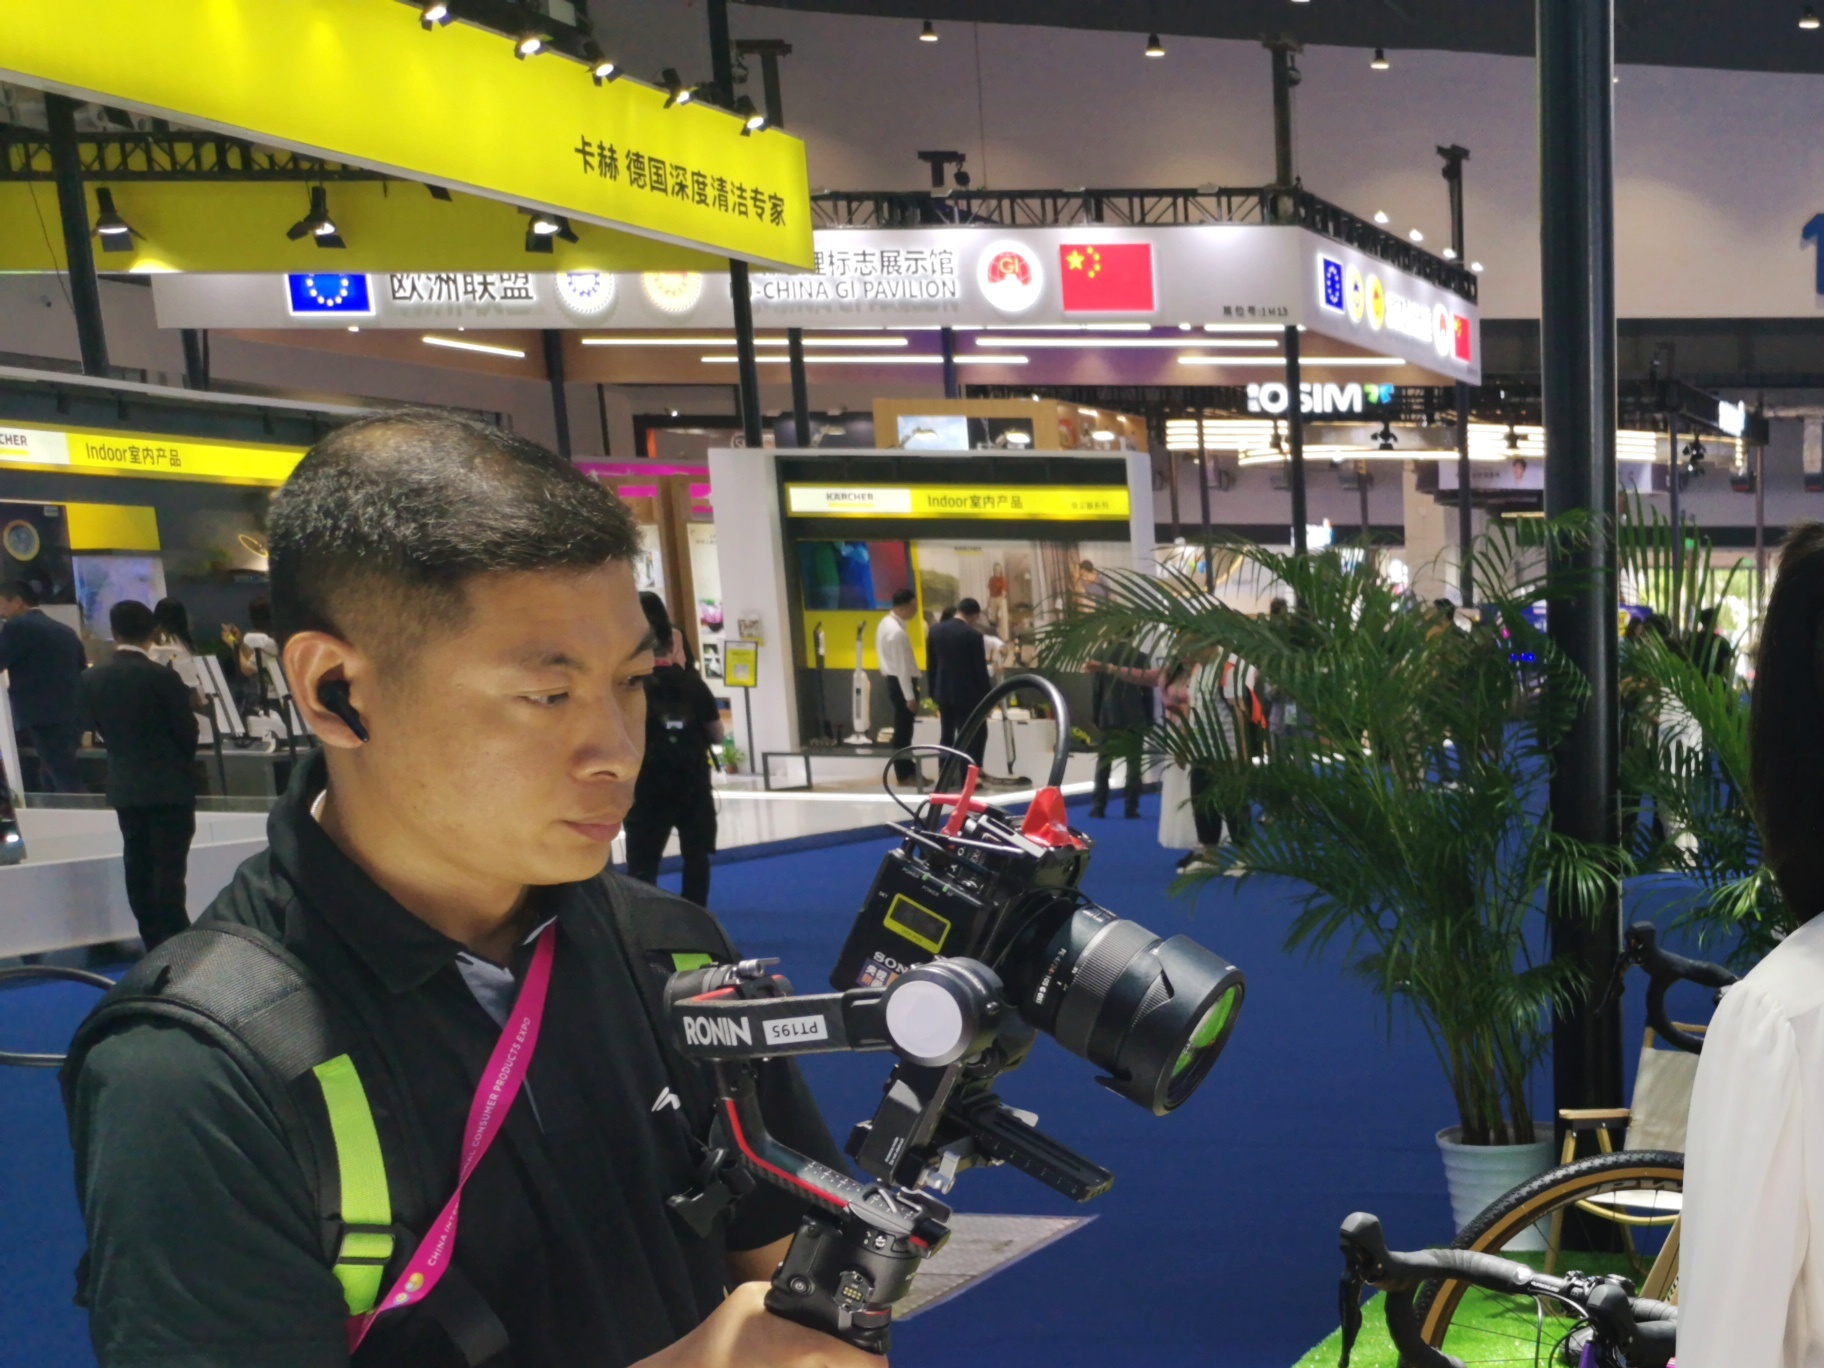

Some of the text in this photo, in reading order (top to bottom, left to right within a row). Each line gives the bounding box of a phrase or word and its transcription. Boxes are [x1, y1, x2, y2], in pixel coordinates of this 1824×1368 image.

[574, 134, 786, 227] 卡赫 德国深度清洁专家
[999, 255, 1020, 273] GI
[836, 281, 856, 299] GI
[864, 280, 957, 298] PAVILION
[85, 443, 182, 467] Indoor室内产品
[927, 495, 1024, 510] Indoor室内产品
[682, 1016, 753, 1047] RONIN
[772, 1021, 818, 1038] PT195
[428, 1233, 448, 1267] CHINA
[471, 1093, 498, 1148] CONSUMER
[492, 1042, 522, 1092] PRODUCTS
[515, 1016, 531, 1043] EXPO
